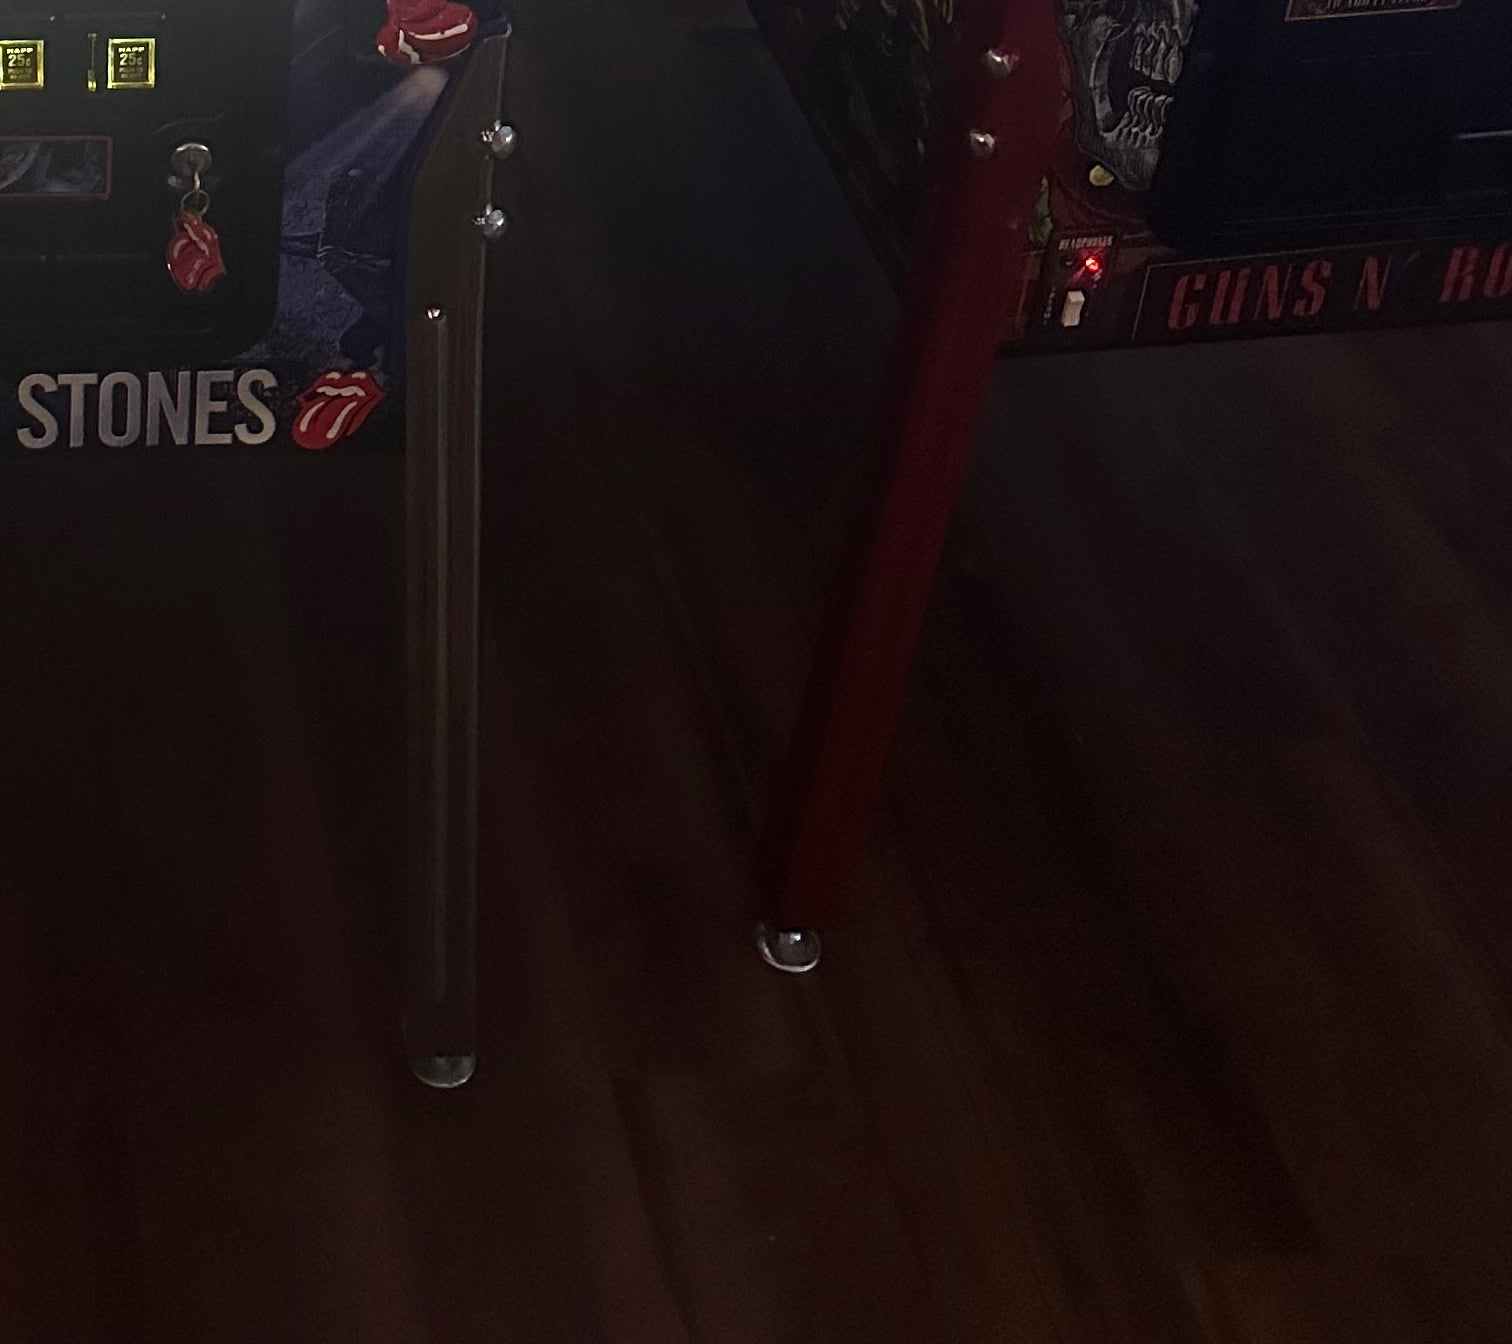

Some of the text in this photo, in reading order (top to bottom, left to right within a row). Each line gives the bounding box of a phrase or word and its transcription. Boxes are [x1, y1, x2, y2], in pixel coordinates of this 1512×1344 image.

[1059, 235, 1114, 251] HEADPHONES
[1167, 259, 1334, 331] GUNS
[16, 368, 278, 450] STONES
